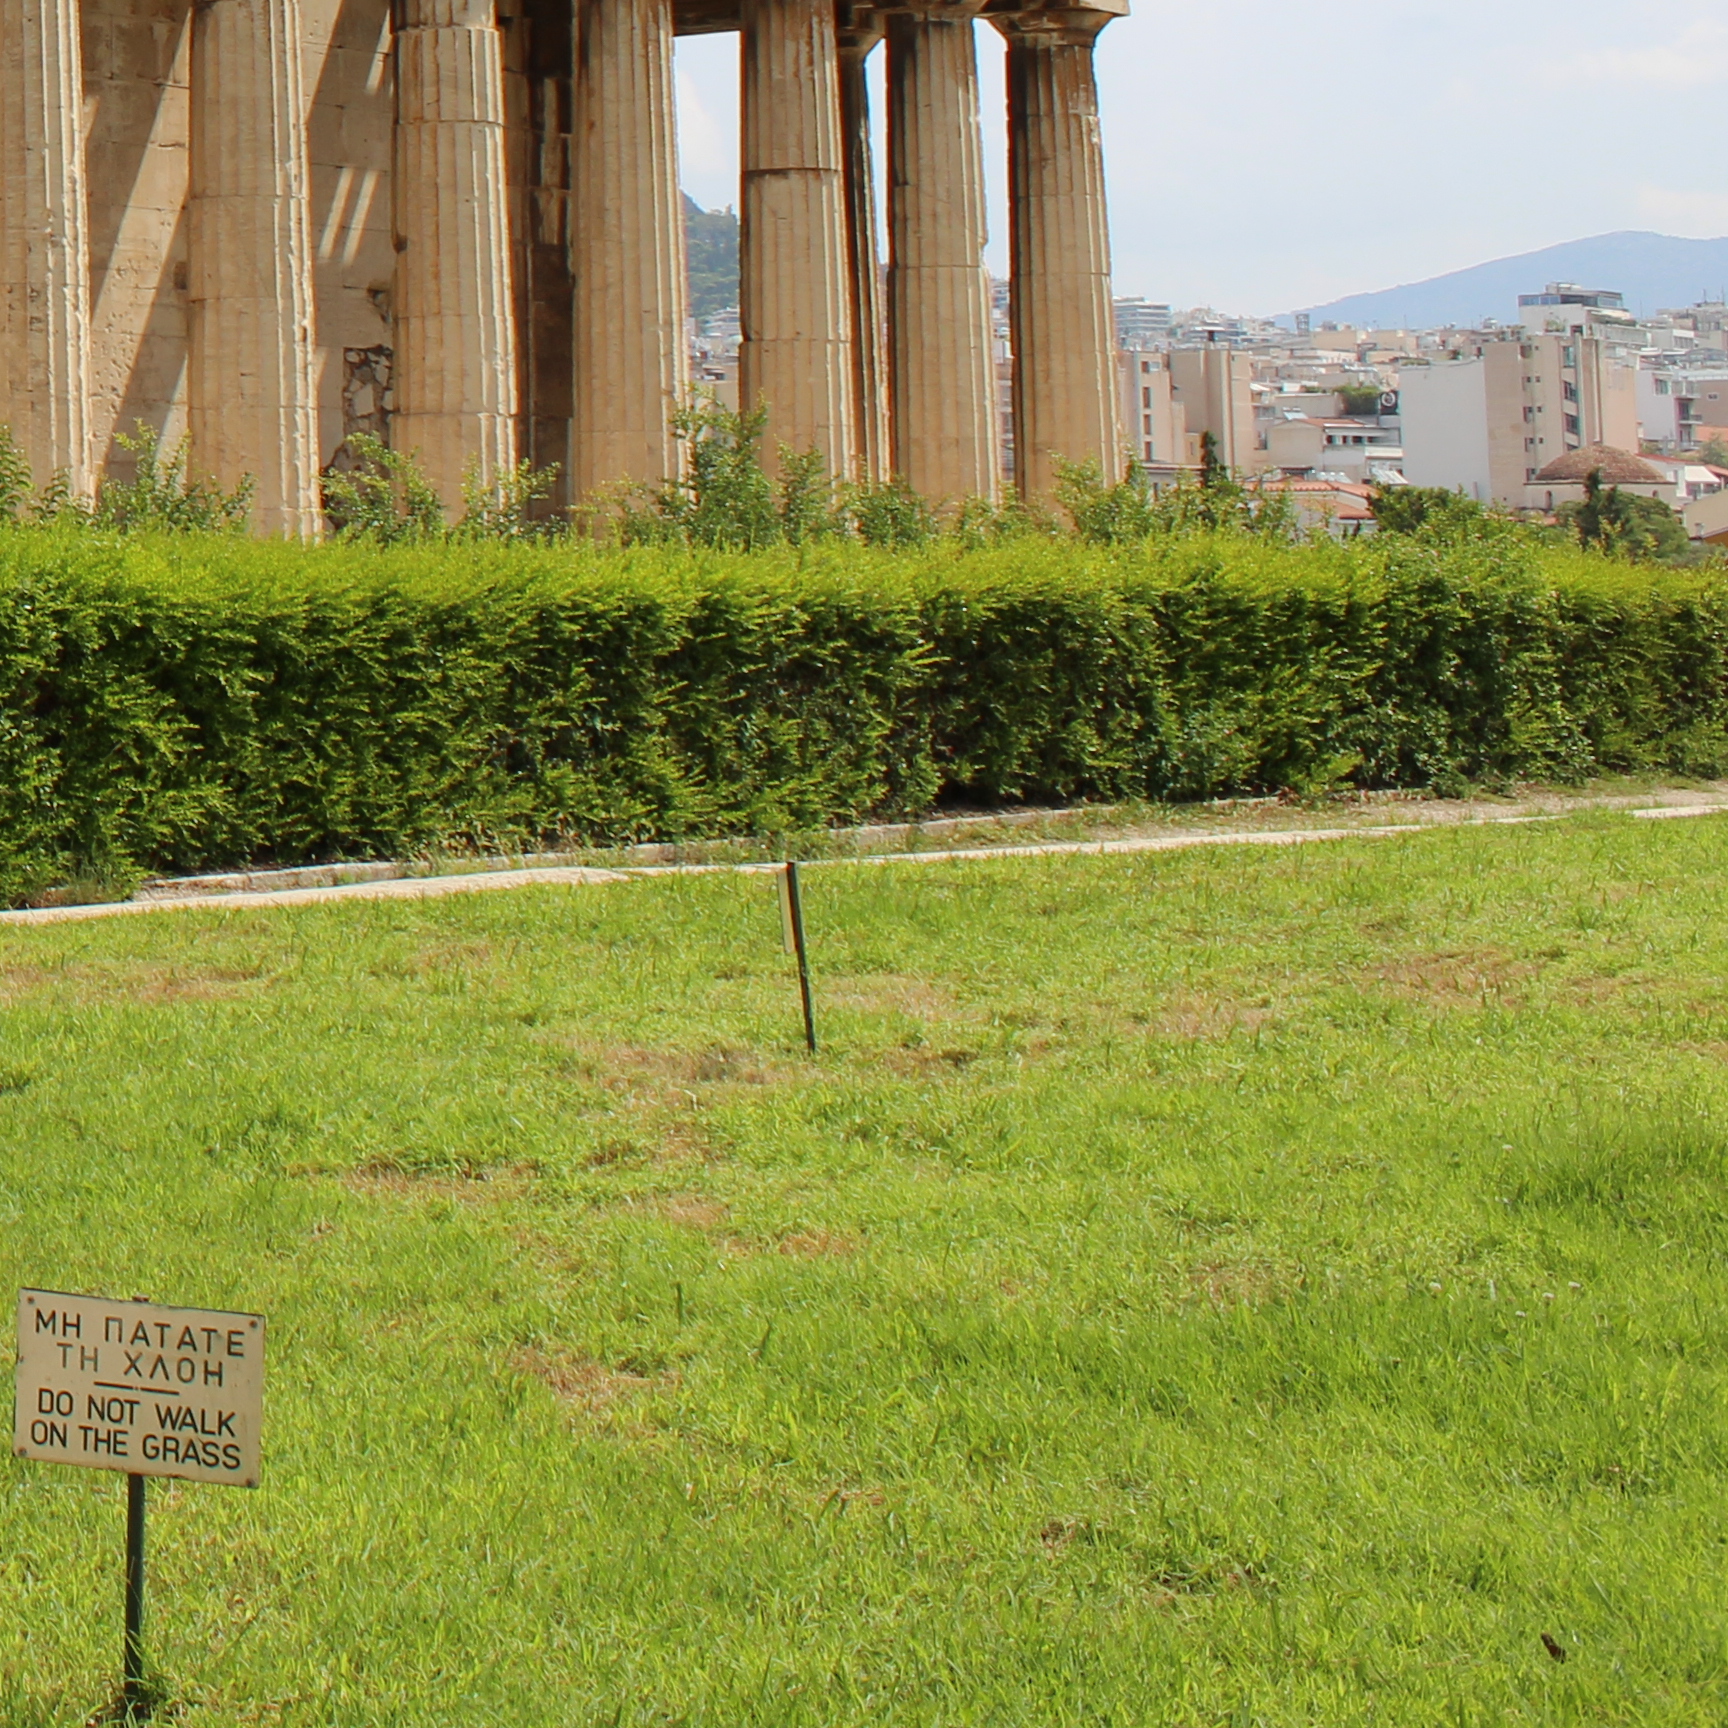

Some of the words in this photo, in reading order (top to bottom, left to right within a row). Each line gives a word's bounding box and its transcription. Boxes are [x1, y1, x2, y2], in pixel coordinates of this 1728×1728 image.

[34, 1308, 80, 1339] ΜΗ
[104, 1316, 245, 1357] ΠΑΤΑΤΕ
[56, 1342, 98, 1372] ΤΗ
[123, 1350, 223, 1387] ΧΛΟΗ
[38, 1388, 73, 1416] DO
[87, 1394, 140, 1425] NOT
[155, 1403, 236, 1437] WALK
[30, 1420, 67, 1448] ON
[78, 1425, 129, 1456] THE
[142, 1434, 241, 1469] GRASS
